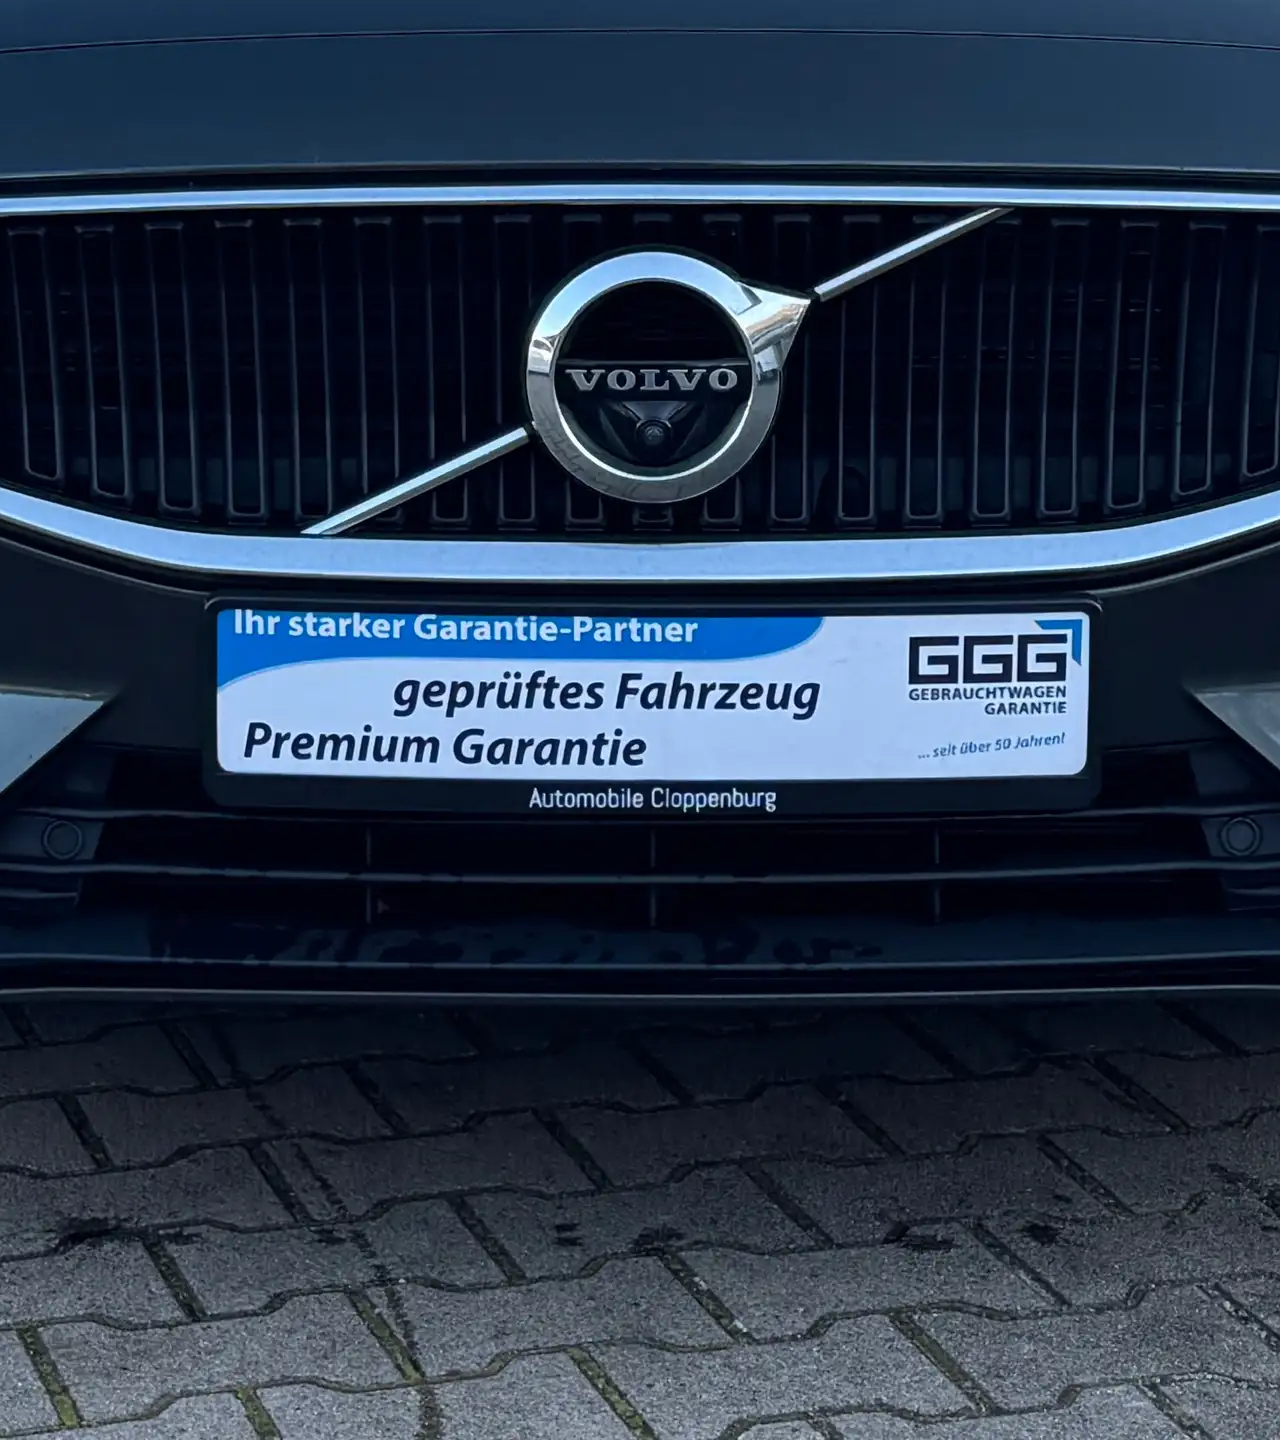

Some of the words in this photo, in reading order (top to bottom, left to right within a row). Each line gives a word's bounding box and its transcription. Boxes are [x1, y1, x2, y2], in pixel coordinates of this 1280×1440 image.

[565, 368, 738, 391] VOLVO
[234, 609, 280, 636] Ihr
[289, 612, 405, 640] starker
[413, 614, 698, 642] Garantie-Partner
[908, 633, 1068, 685] GGG
[393, 670, 605, 718] geprüftes
[615, 671, 821, 720] Fahrzeug
[908, 685, 1067, 701] GEBRAUCHTWAGEN
[984, 701, 1067, 715] GARANTIE
[242, 722, 440, 764] Premium
[452, 727, 648, 766] Garantie
[932, 743, 956, 758] seit
[960, 740, 992, 754] über
[1015, 731, 1066, 749] Jahren!
[529, 787, 645, 810] Automobile
[650, 787, 777, 812] Cloppenburg
